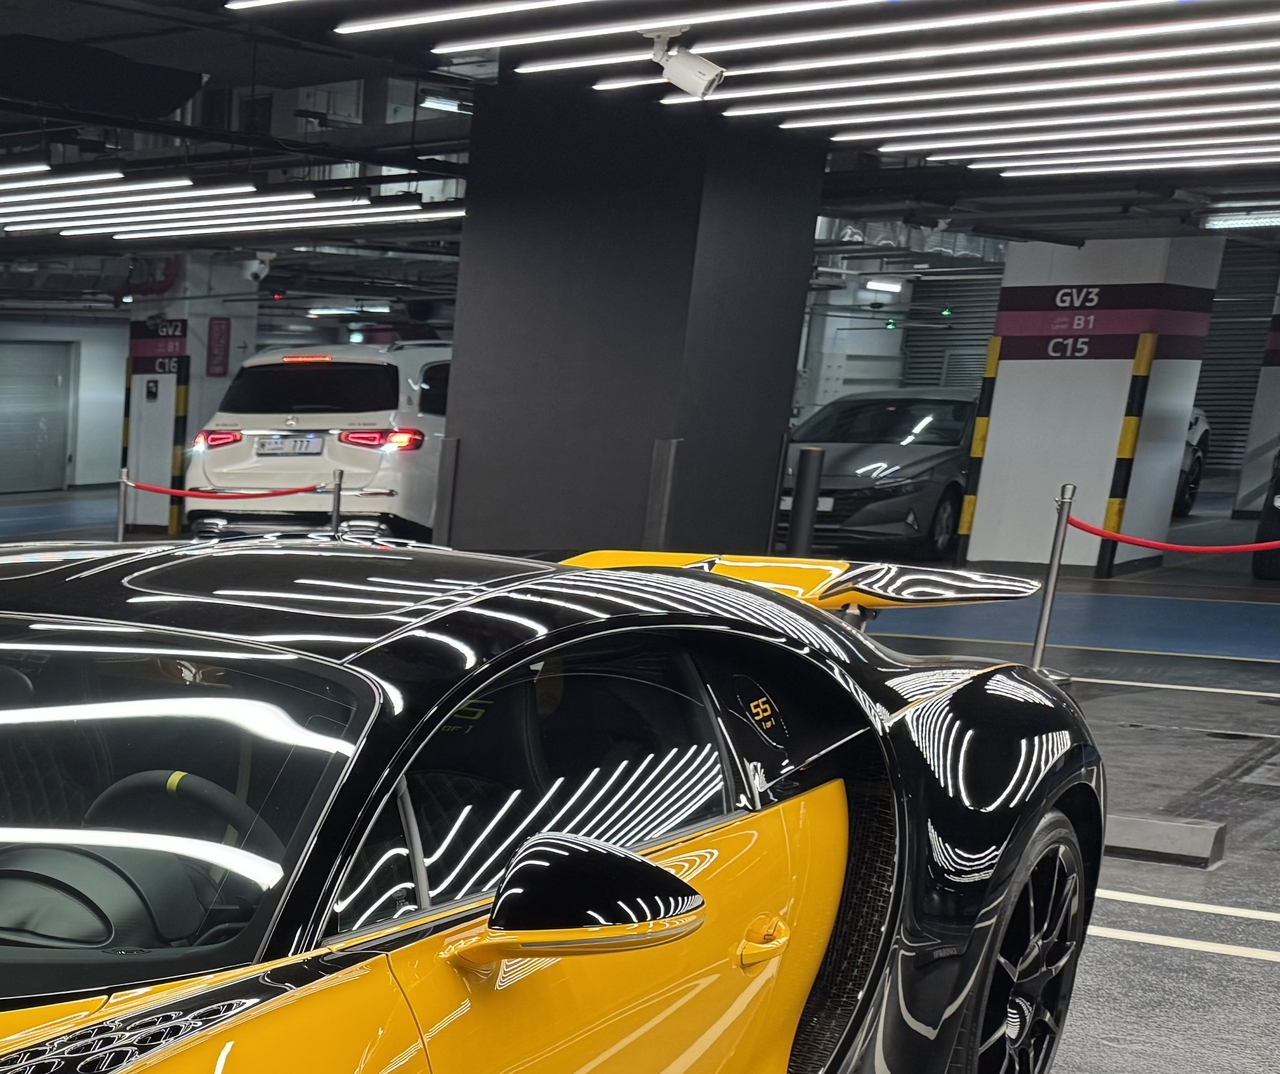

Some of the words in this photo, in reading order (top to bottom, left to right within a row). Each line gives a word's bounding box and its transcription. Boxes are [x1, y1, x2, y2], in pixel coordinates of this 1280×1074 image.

[1055, 287, 1100, 307] GV3
[157, 321, 182, 336] GV2
[1072, 315, 1095, 329] B1
[1047, 337, 1090, 357] C15
[154, 357, 179, 373] C16
[292, 440, 310, 451] 777
[749, 697, 772, 721] 55
